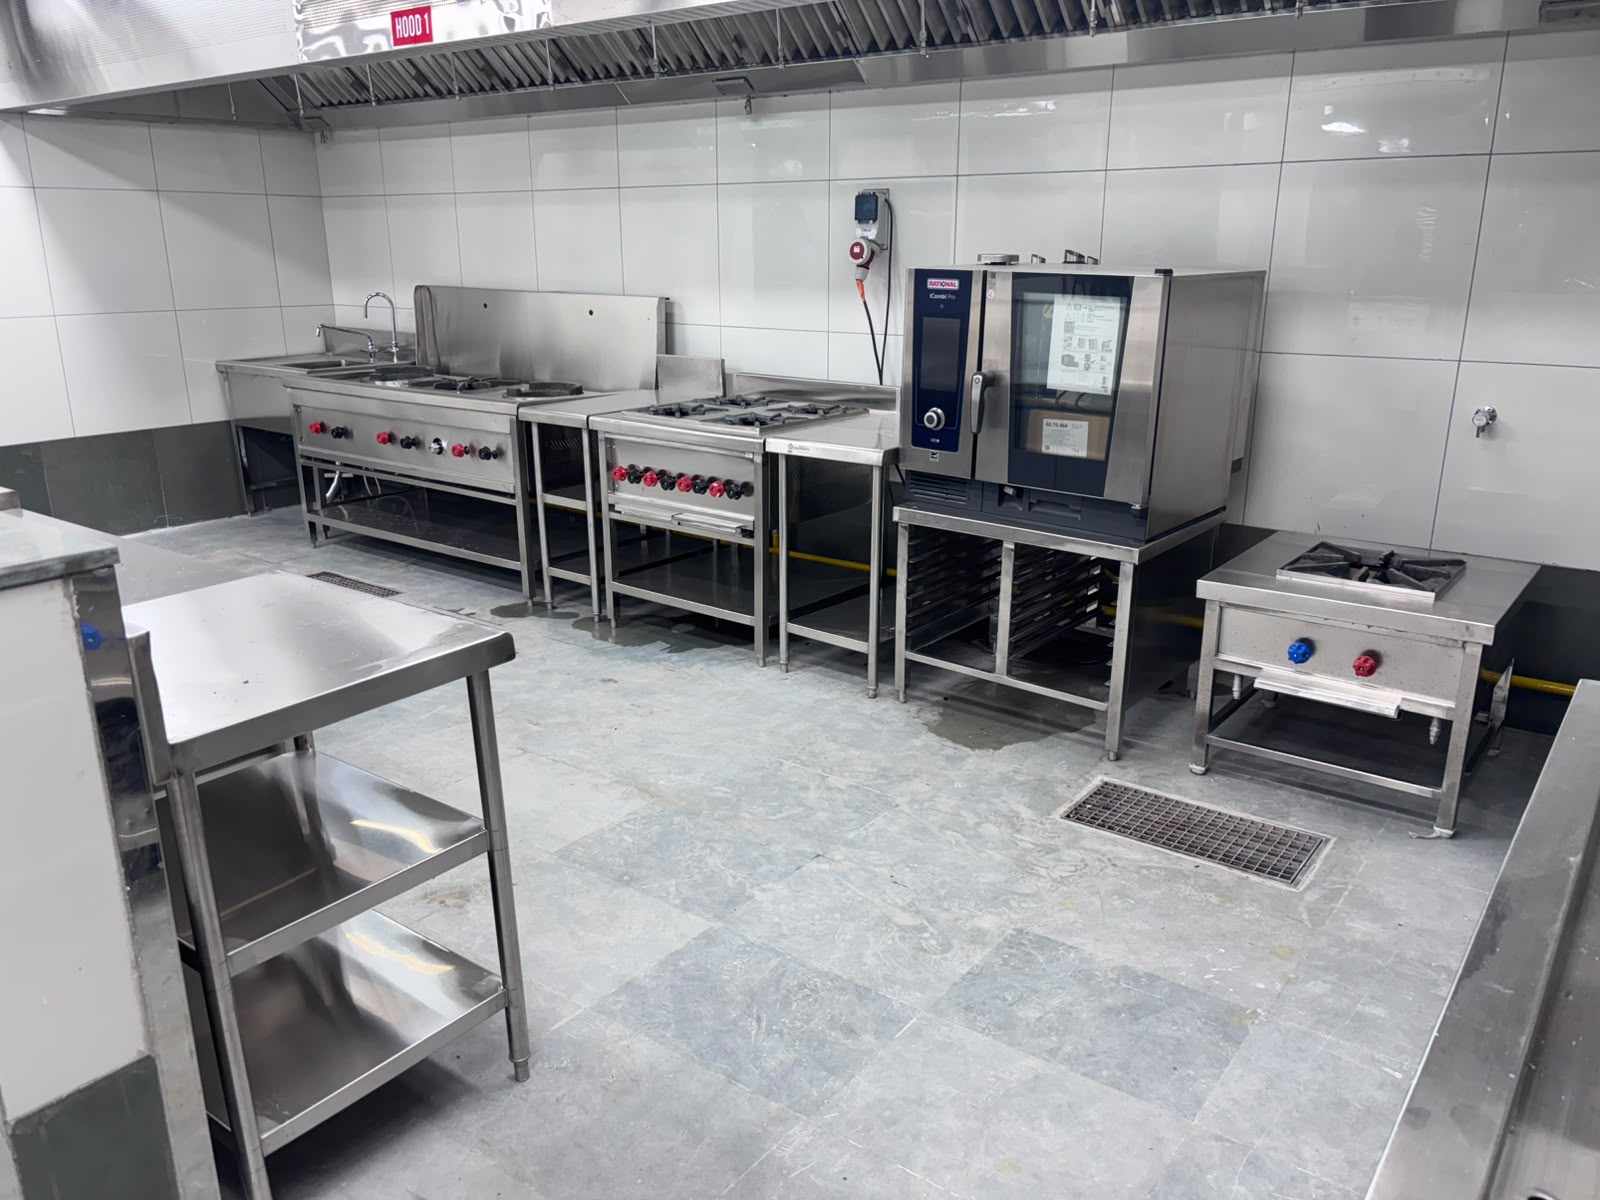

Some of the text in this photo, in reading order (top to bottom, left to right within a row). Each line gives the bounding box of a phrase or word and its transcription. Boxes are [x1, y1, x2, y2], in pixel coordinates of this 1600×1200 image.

[395, 12, 430, 38] HOOD 1
[928, 280, 957, 288] RATIONAL
[929, 292, 947, 300] iCombi
